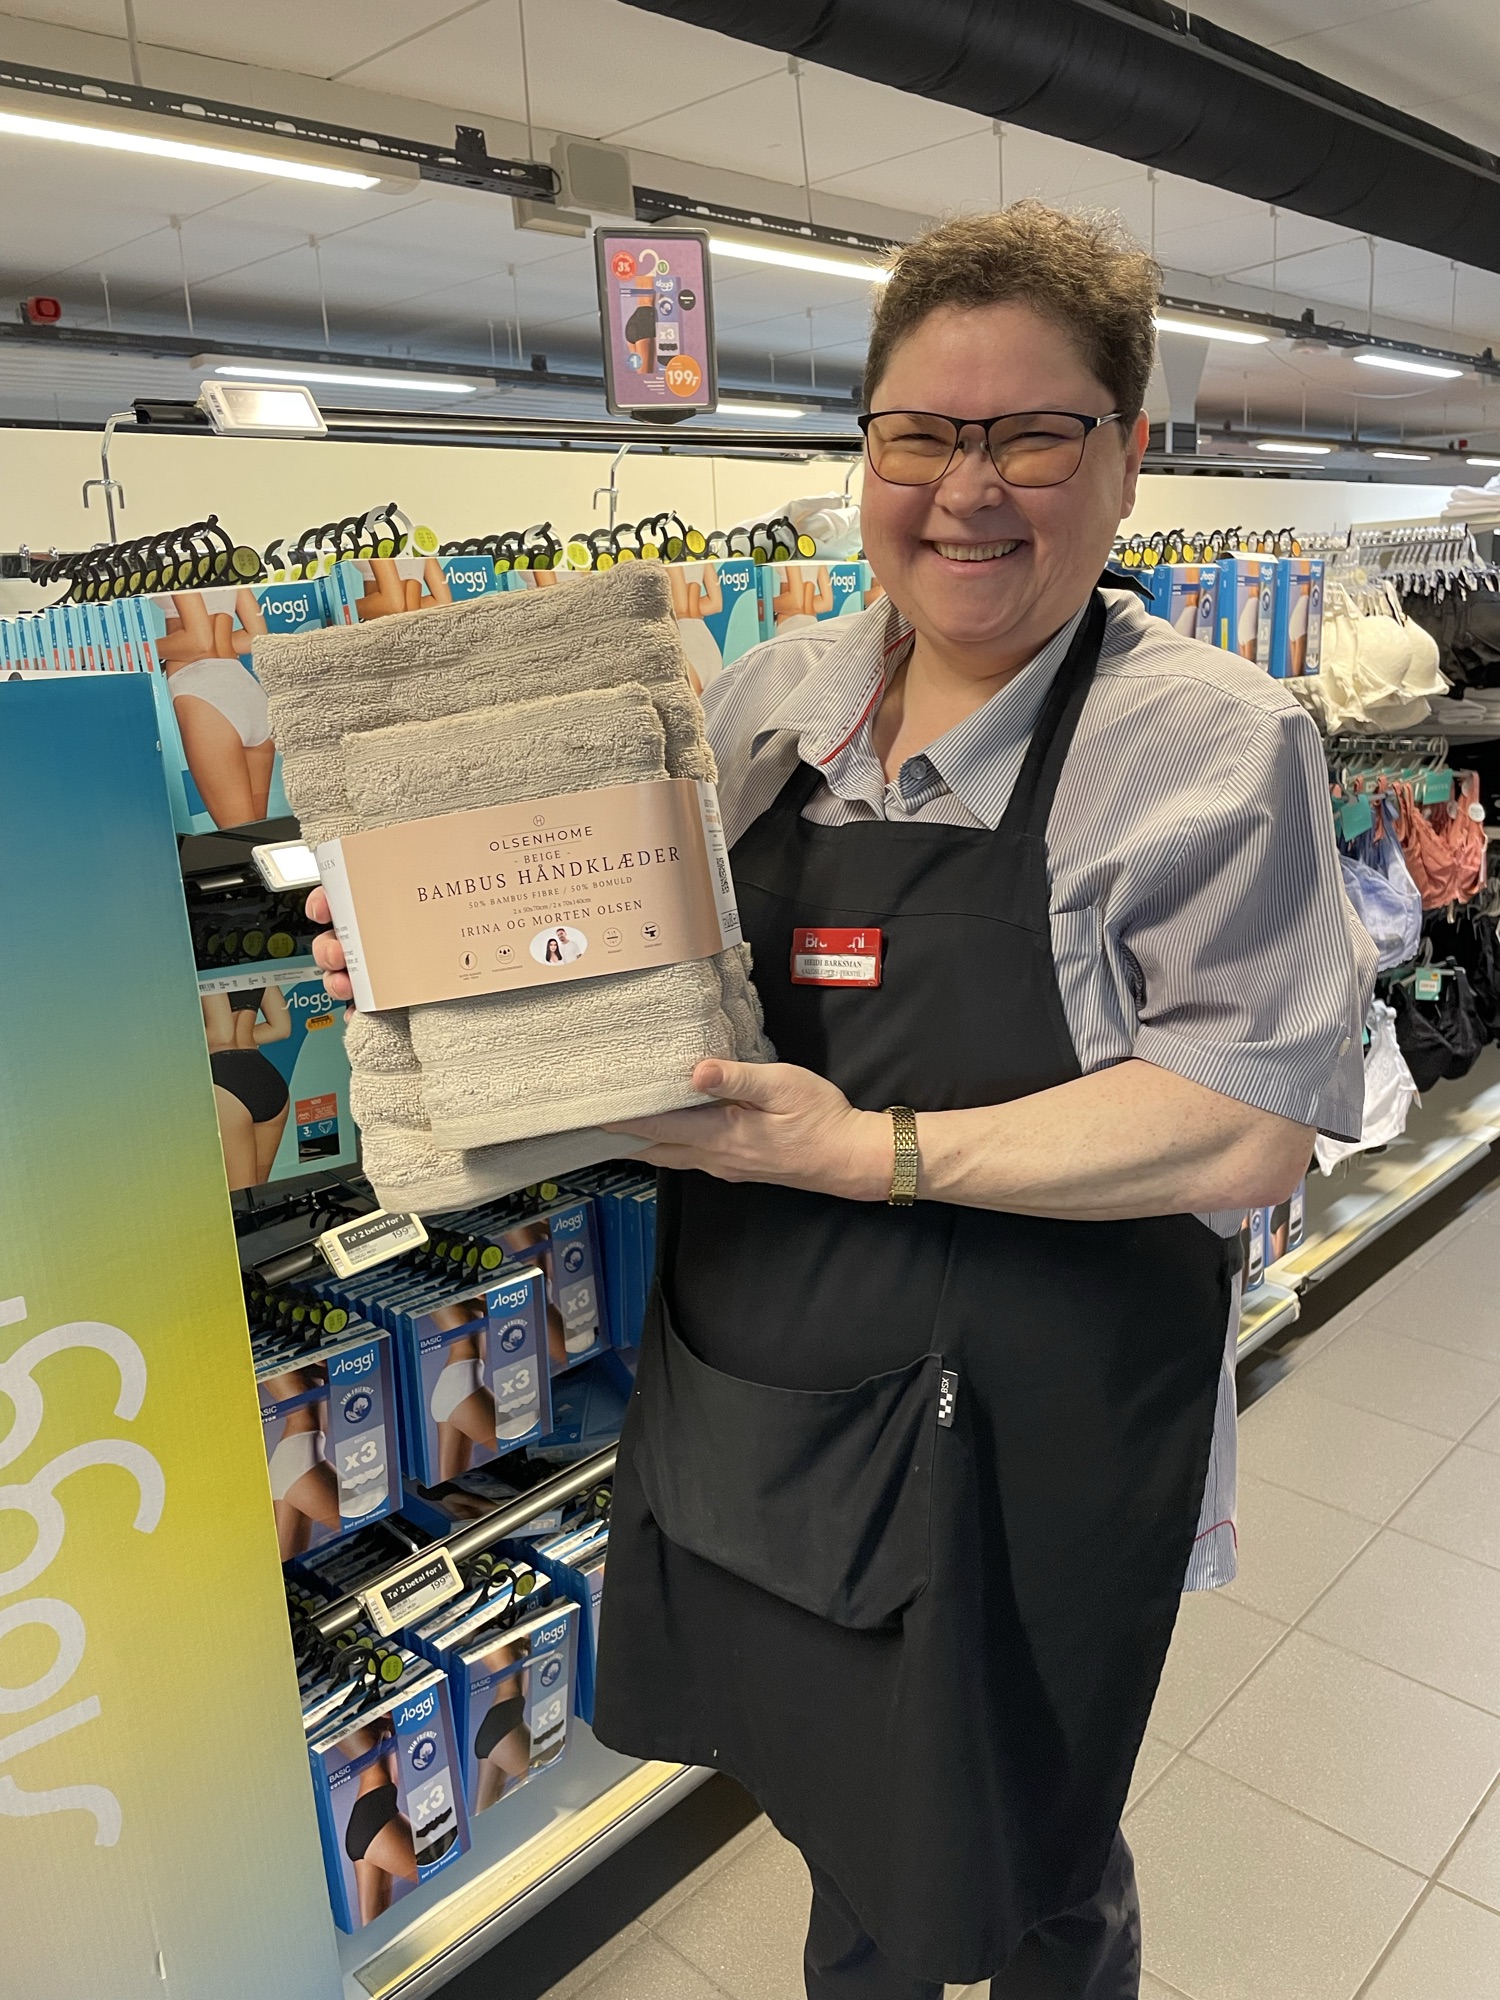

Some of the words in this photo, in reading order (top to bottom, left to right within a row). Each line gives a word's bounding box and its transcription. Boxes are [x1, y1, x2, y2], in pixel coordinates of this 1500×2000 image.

[659, 328, 675, 340] x3
[441, 566, 488, 592] sloggi
[717, 569, 750, 592] sloggi
[828, 571, 856, 593] sloggi
[256, 594, 310, 624] sloggi
[489, 825, 594, 852] OLSENHOME
[523, 850, 561, 864] BEIGE
[417, 873, 508, 902] BAMBUS
[517, 846, 681, 886] HÅNDKLÆDER
[468, 900, 486, 909] 50%
[490, 892, 529, 906] BAMBUS
[532, 887, 559, 899] FIBRE
[570, 882, 589, 893] 50%
[592, 876, 633, 889] BOMULD
[461, 923, 501, 938] IRINA
[506, 918, 527, 930] OG
[532, 908, 591, 927] MORTEN
[597, 899, 643, 915] OLSEN
[824, 959, 862, 968] BARKSMAN
[281, 992, 336, 1014] slogg
[344, 1233, 358, 1244] Ta'
[364, 1222, 387, 1236] betal
[386, 1218, 399, 1227] for
[553, 1210, 584, 1233] sloggi
[490, 1284, 528, 1310] sloggi
[567, 1289, 590, 1314] x3
[420, 1335, 442, 1348] BASIC
[420, 1344, 442, 1355] COTTON
[332, 1349, 374, 1377] sloggi
[501, 1369, 530, 1397] x3
[941, 1377, 950, 1393] BSX
[344, 1440, 378, 1472] x3
[354, 1517, 366, 1527] your
[386, 1588, 399, 1600] Ta'
[400, 1585, 408, 1594] 2
[405, 1572, 426, 1589] betal
[425, 1567, 438, 1577] for
[534, 1619, 567, 1647] sloggi
[470, 1676, 492, 1691] BASIC
[397, 1692, 434, 1727] sloggi
[536, 1699, 561, 1730] x3
[329, 1766, 352, 1783] BASIC
[330, 1775, 351, 1790] COTTON
[415, 1784, 445, 1821] x3
